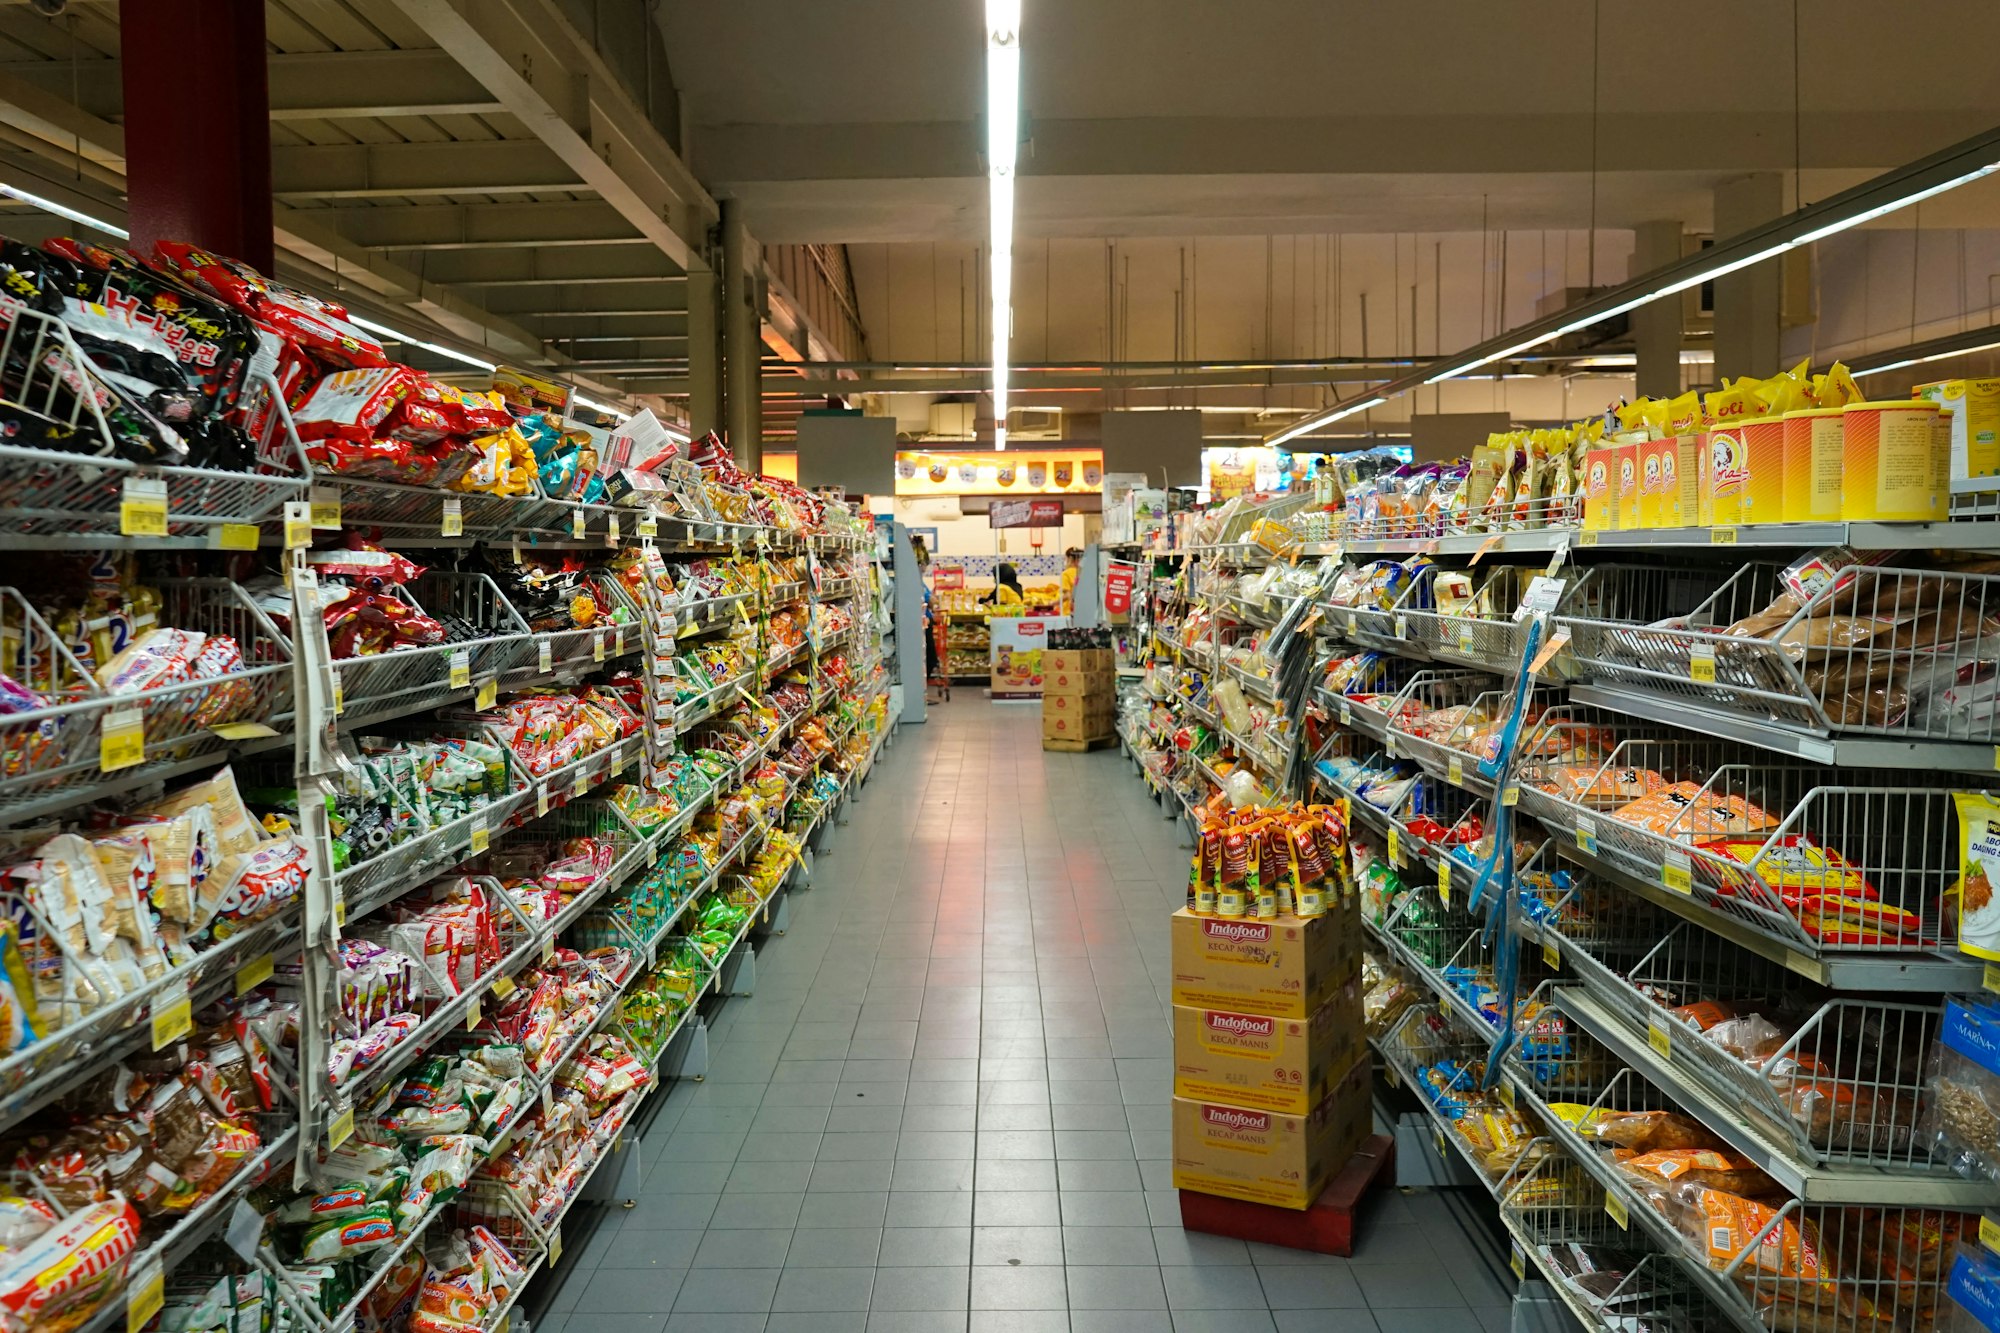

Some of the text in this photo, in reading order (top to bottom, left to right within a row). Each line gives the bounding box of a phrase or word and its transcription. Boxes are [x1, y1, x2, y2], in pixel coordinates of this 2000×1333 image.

[1985, 836, 2000, 848] ABO
[1209, 922, 1267, 940] Indofood
[1208, 942, 1235, 953] KECAP
[1212, 1015, 1270, 1034] Indofood
[1210, 1034, 1269, 1050] KECAP MANIS
[1209, 1109, 1266, 1128] Indofood
[1207, 1128, 1266, 1145] KECAP MANIS
